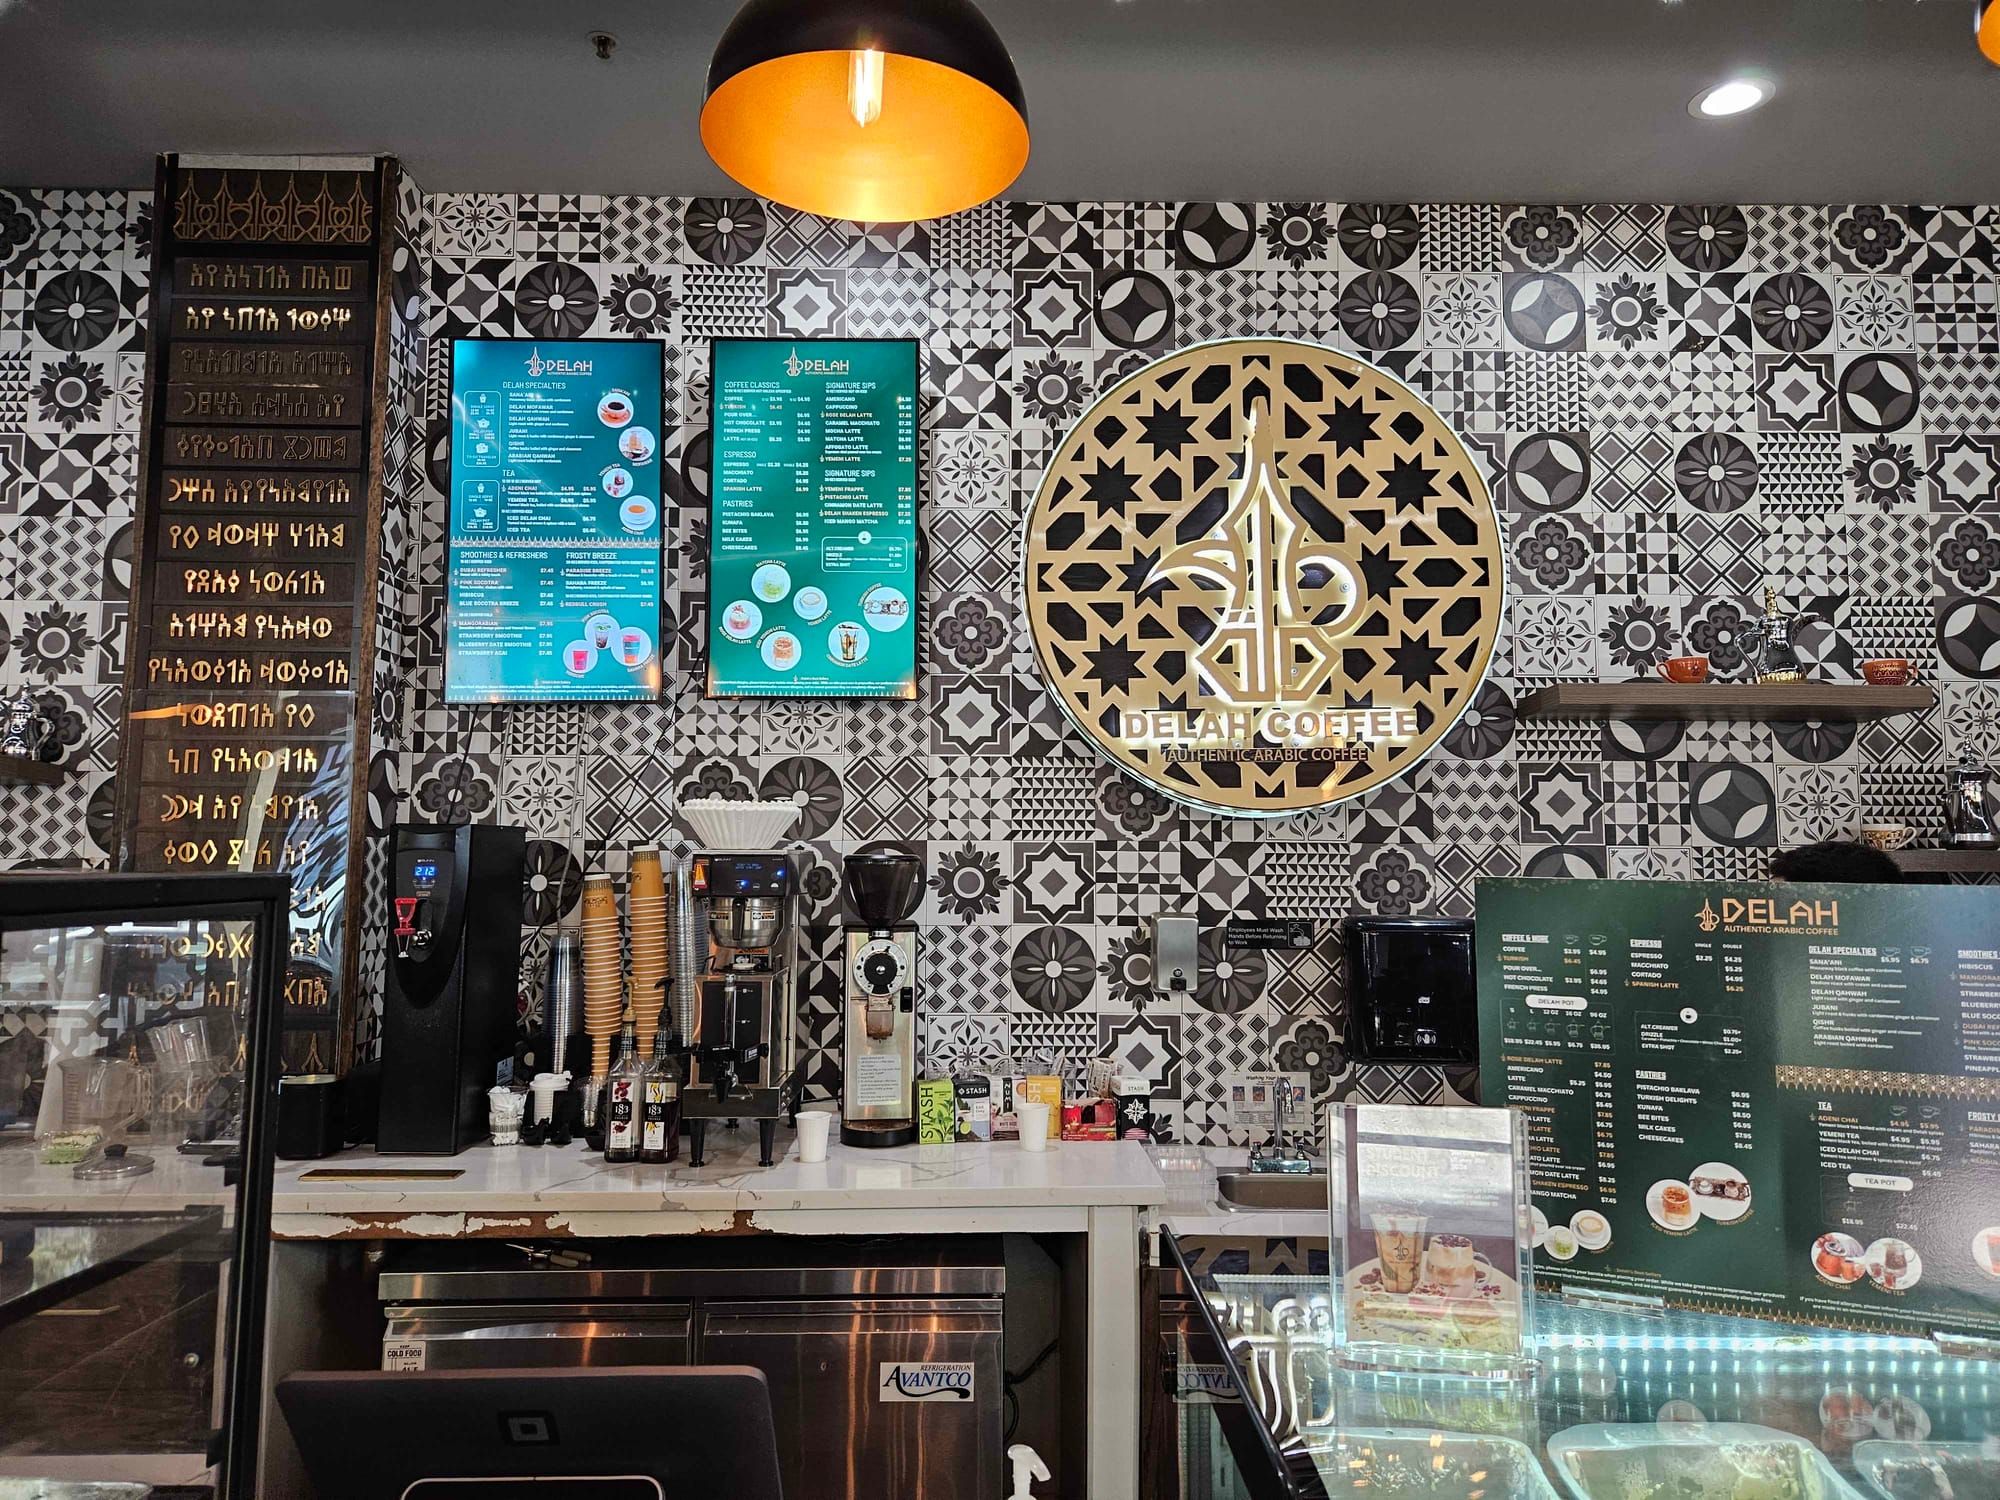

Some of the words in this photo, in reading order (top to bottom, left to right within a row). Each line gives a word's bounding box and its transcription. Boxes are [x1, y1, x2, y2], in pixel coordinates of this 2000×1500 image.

[546, 360, 592, 371] DELAH
[804, 360, 849, 371] DELAH
[503, 381, 524, 389] DELAH
[460, 551, 497, 559] SMOOTHIES
[1124, 710, 1253, 739] DELAH
[1266, 709, 1419, 738] COFFEE
[1167, 749, 1253, 762] AUTHENTIC
[1254, 749, 1309, 761] ARABIC
[1311, 748, 1368, 761] COFFEE
[415, 866, 435, 876] 212
[1722, 898, 1838, 926] DELAH
[1724, 925, 1771, 934] AUTHENTIC
[1773, 926, 1804, 934] ARABIC
[1806, 927, 1839, 936] COFFEE
[1809, 946, 1831, 955] DELAH
[1832, 946, 1877, 956] SPECIALTIES
[1958, 950, 1997, 959] SMOOTHIES
[1631, 971, 1662, 979] CORTADO
[1845, 1035, 1877, 1043] QAHWAH
[1507, 1065, 1543, 1073] AMERICANO
[965, 1087, 987, 1095] STASH
[1537, 1087, 1574, 1095] MACCHIATO
[1595, 1091, 1612, 1099] $6.75
[1636, 1084, 1670, 1092] PISTACHIO
[1670, 1087, 1700, 1095] BAKLAVA
[1731, 1091, 1750, 1099] $6.95
[1004, 1082, 1012, 1111] NUMI
[1508, 1094, 1548, 1103] CAPPUCCINO
[1596, 1101, 1613, 1109] $5.45
[1637, 1094, 1664, 1102] TURKISH
[1665, 1096, 1698, 1105] DELIGHTS
[1818, 1101, 1832, 1111] TEA
[921, 1087, 933, 1139] STASH
[1968, 1112, 1995, 1121] FROSTY
[1655, 1125, 1676, 1133] CAKES
[1638, 1134, 1684, 1144] CHEESECAKES
[1819, 1130, 1845, 1138] YEMENI
[1891, 1136, 1910, 1144] $4.95
[1558, 1182, 1589, 1191] ESPRESSO
[1551, 1192, 1577, 1200] MATCHA
[882, 1365, 971, 1389] AVANTCO
